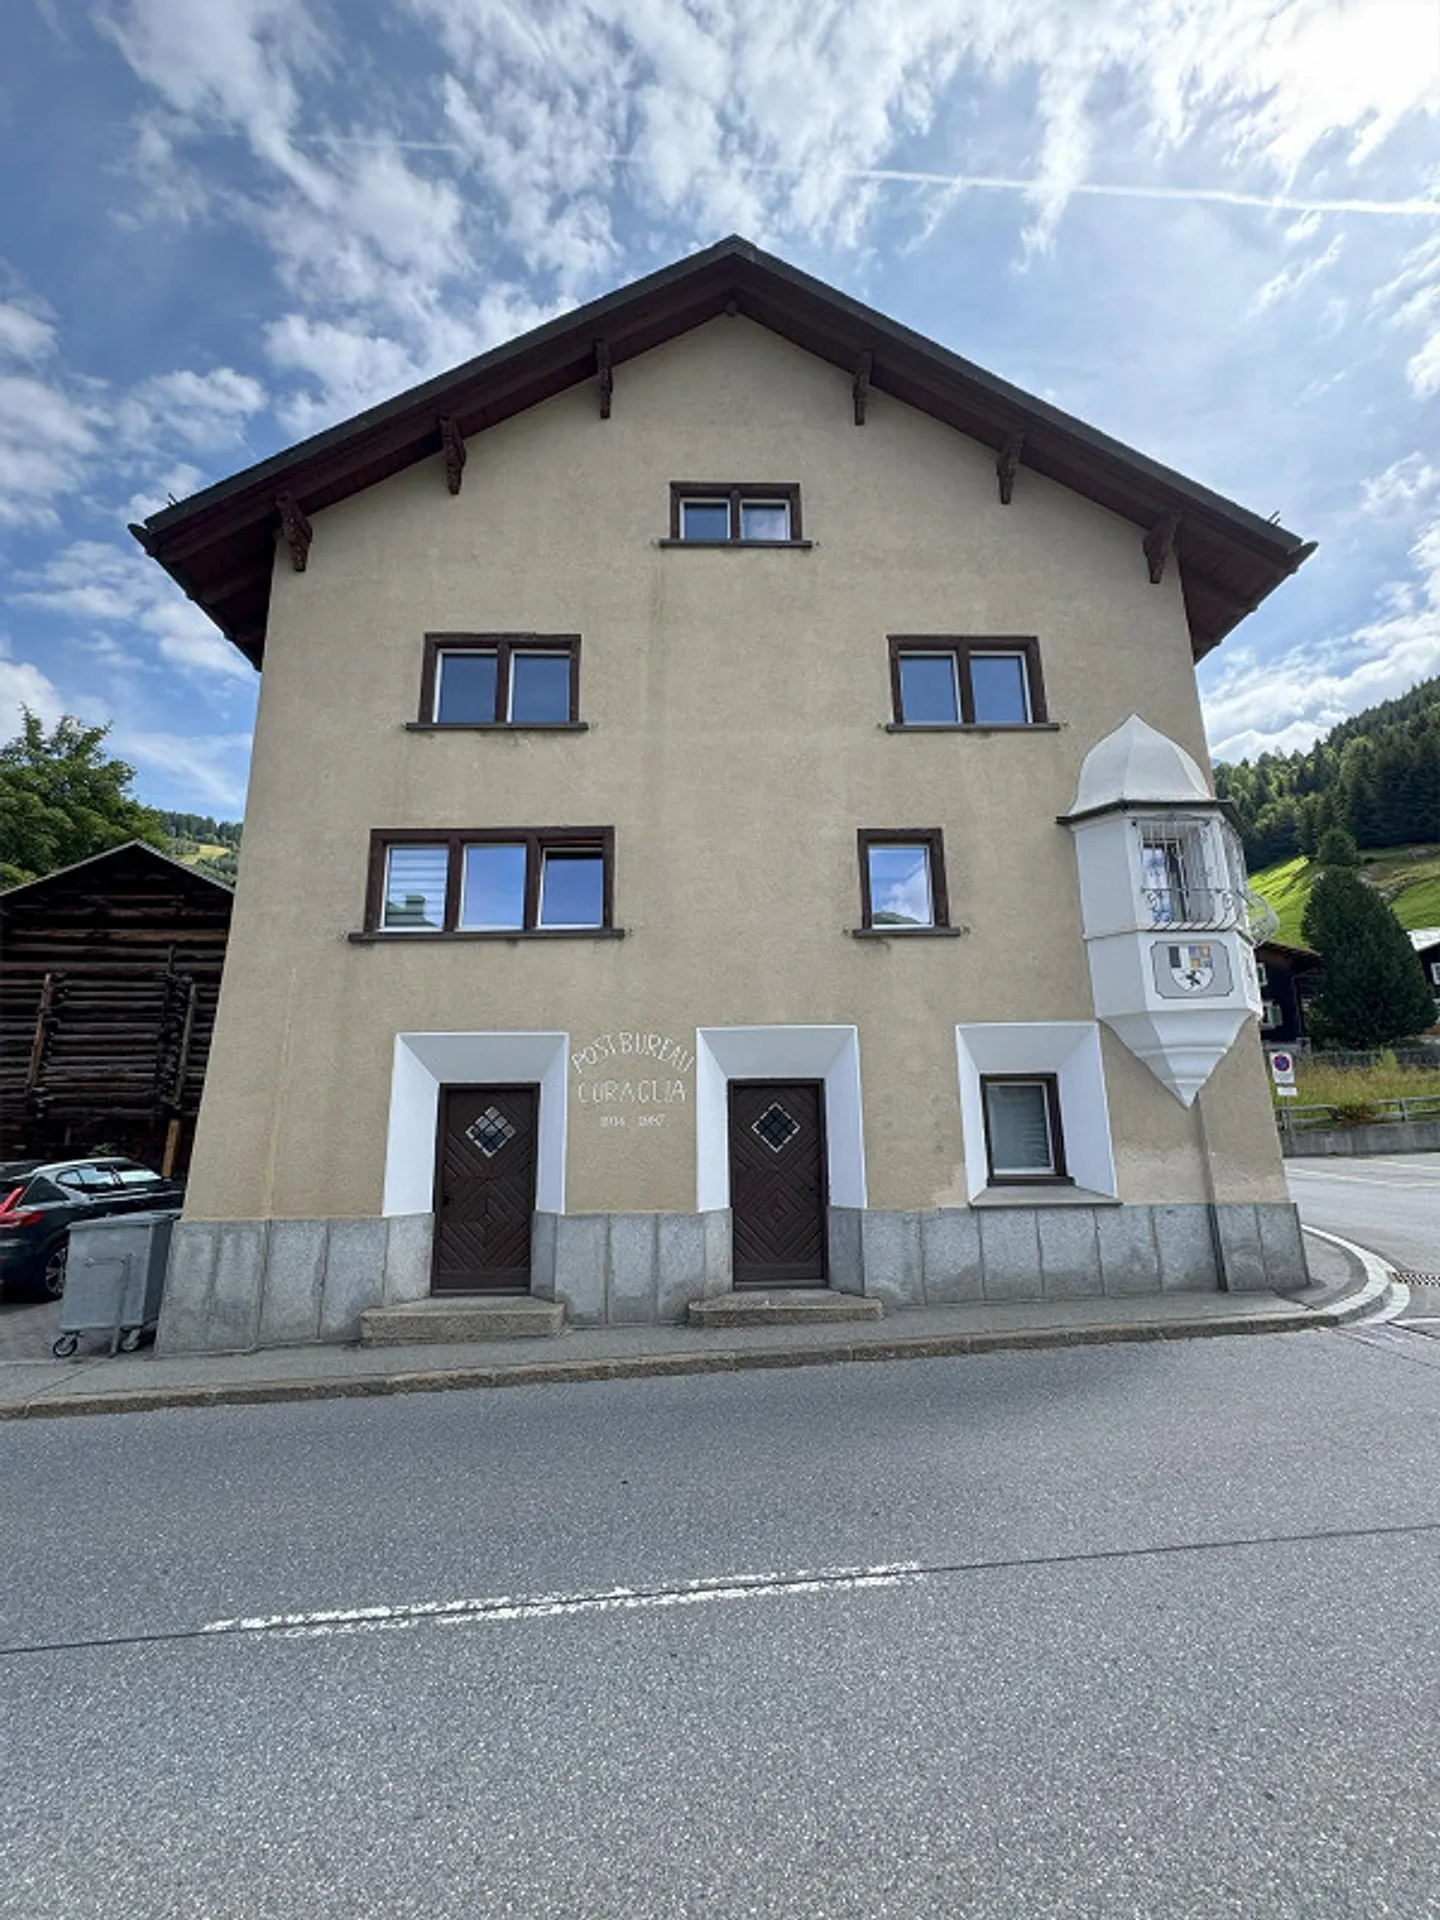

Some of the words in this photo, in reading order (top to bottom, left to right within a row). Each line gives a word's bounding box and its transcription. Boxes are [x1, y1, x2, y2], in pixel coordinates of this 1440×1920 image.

[571, 1035, 616, 1074] POST
[619, 1032, 695, 1073] BUREAU
[578, 1080, 686, 1102] CURAGLIA
